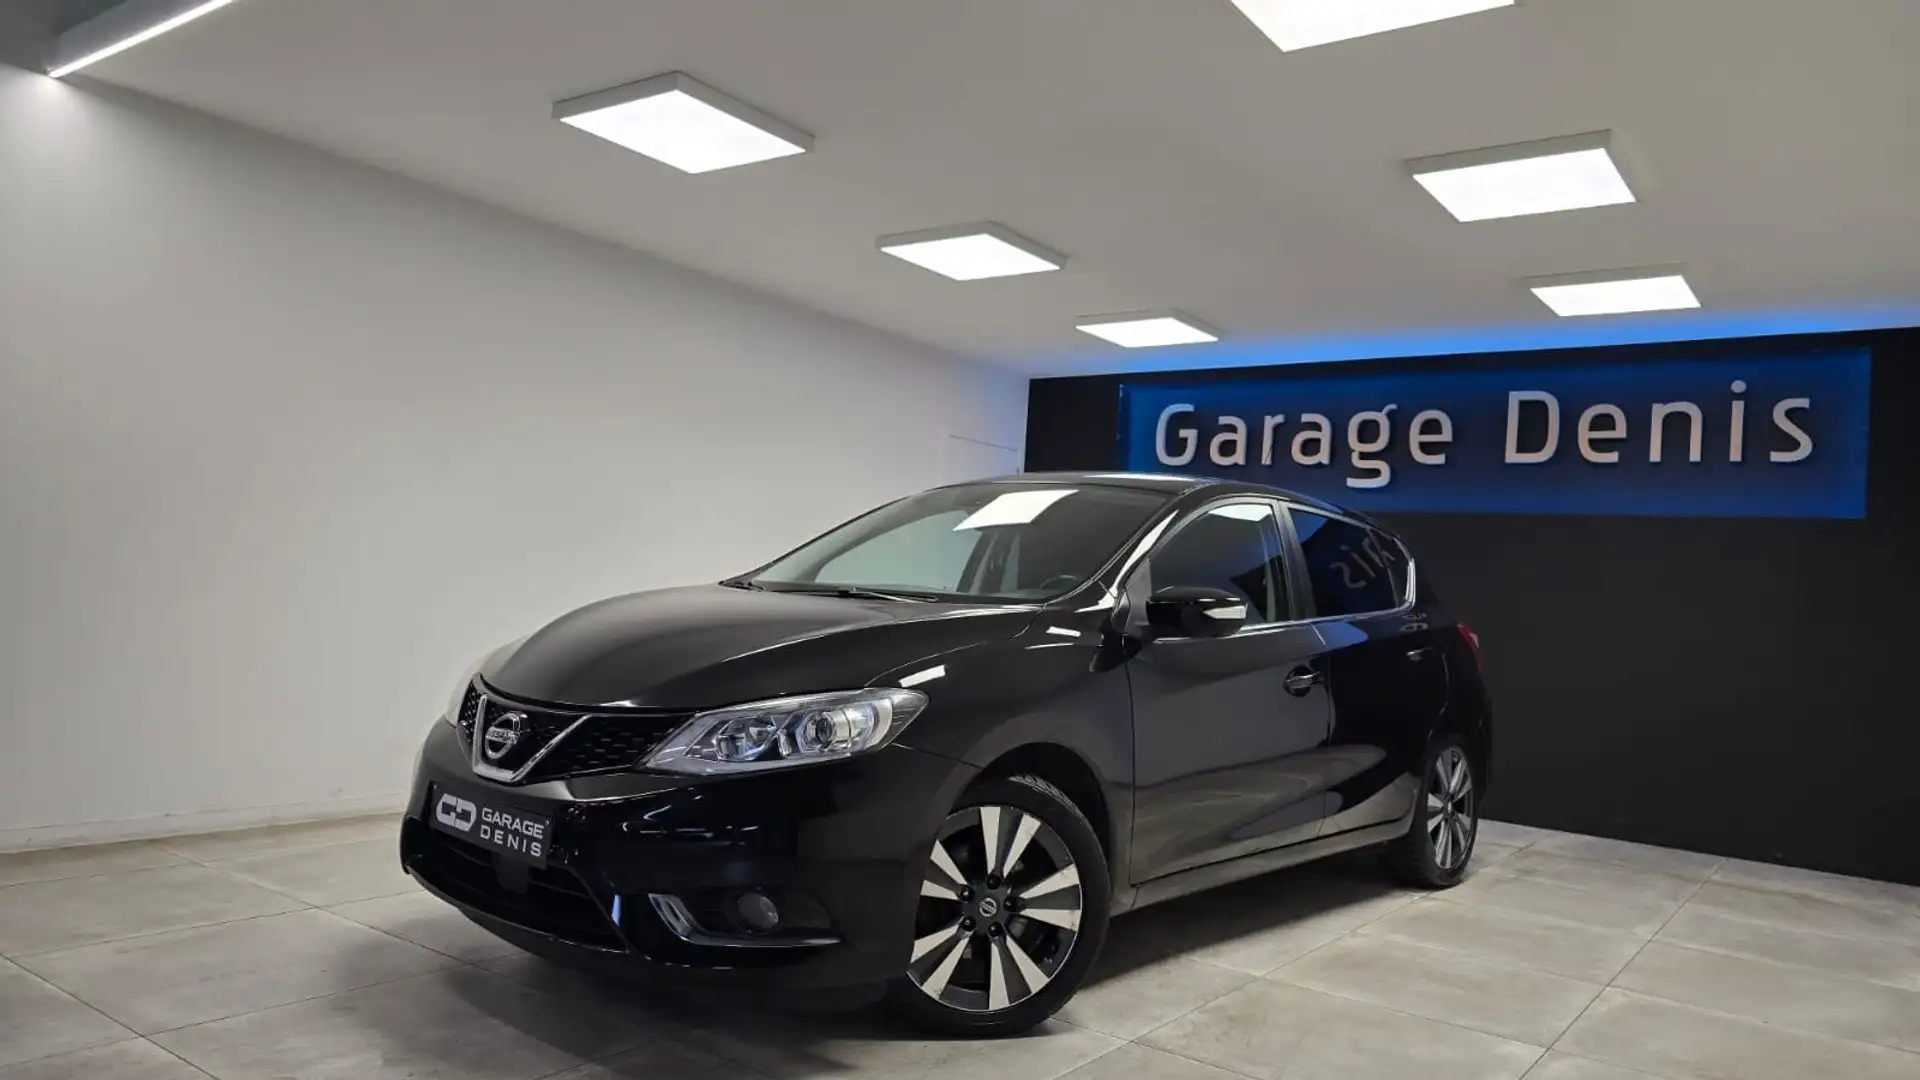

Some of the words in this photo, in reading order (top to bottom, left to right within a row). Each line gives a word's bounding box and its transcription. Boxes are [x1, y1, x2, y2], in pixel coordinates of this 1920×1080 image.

[1155, 402, 1453, 488] Garage
[1505, 380, 1814, 464] Denis
[482, 808, 544, 839] GARAGE
[480, 825, 542, 857] DENIS
